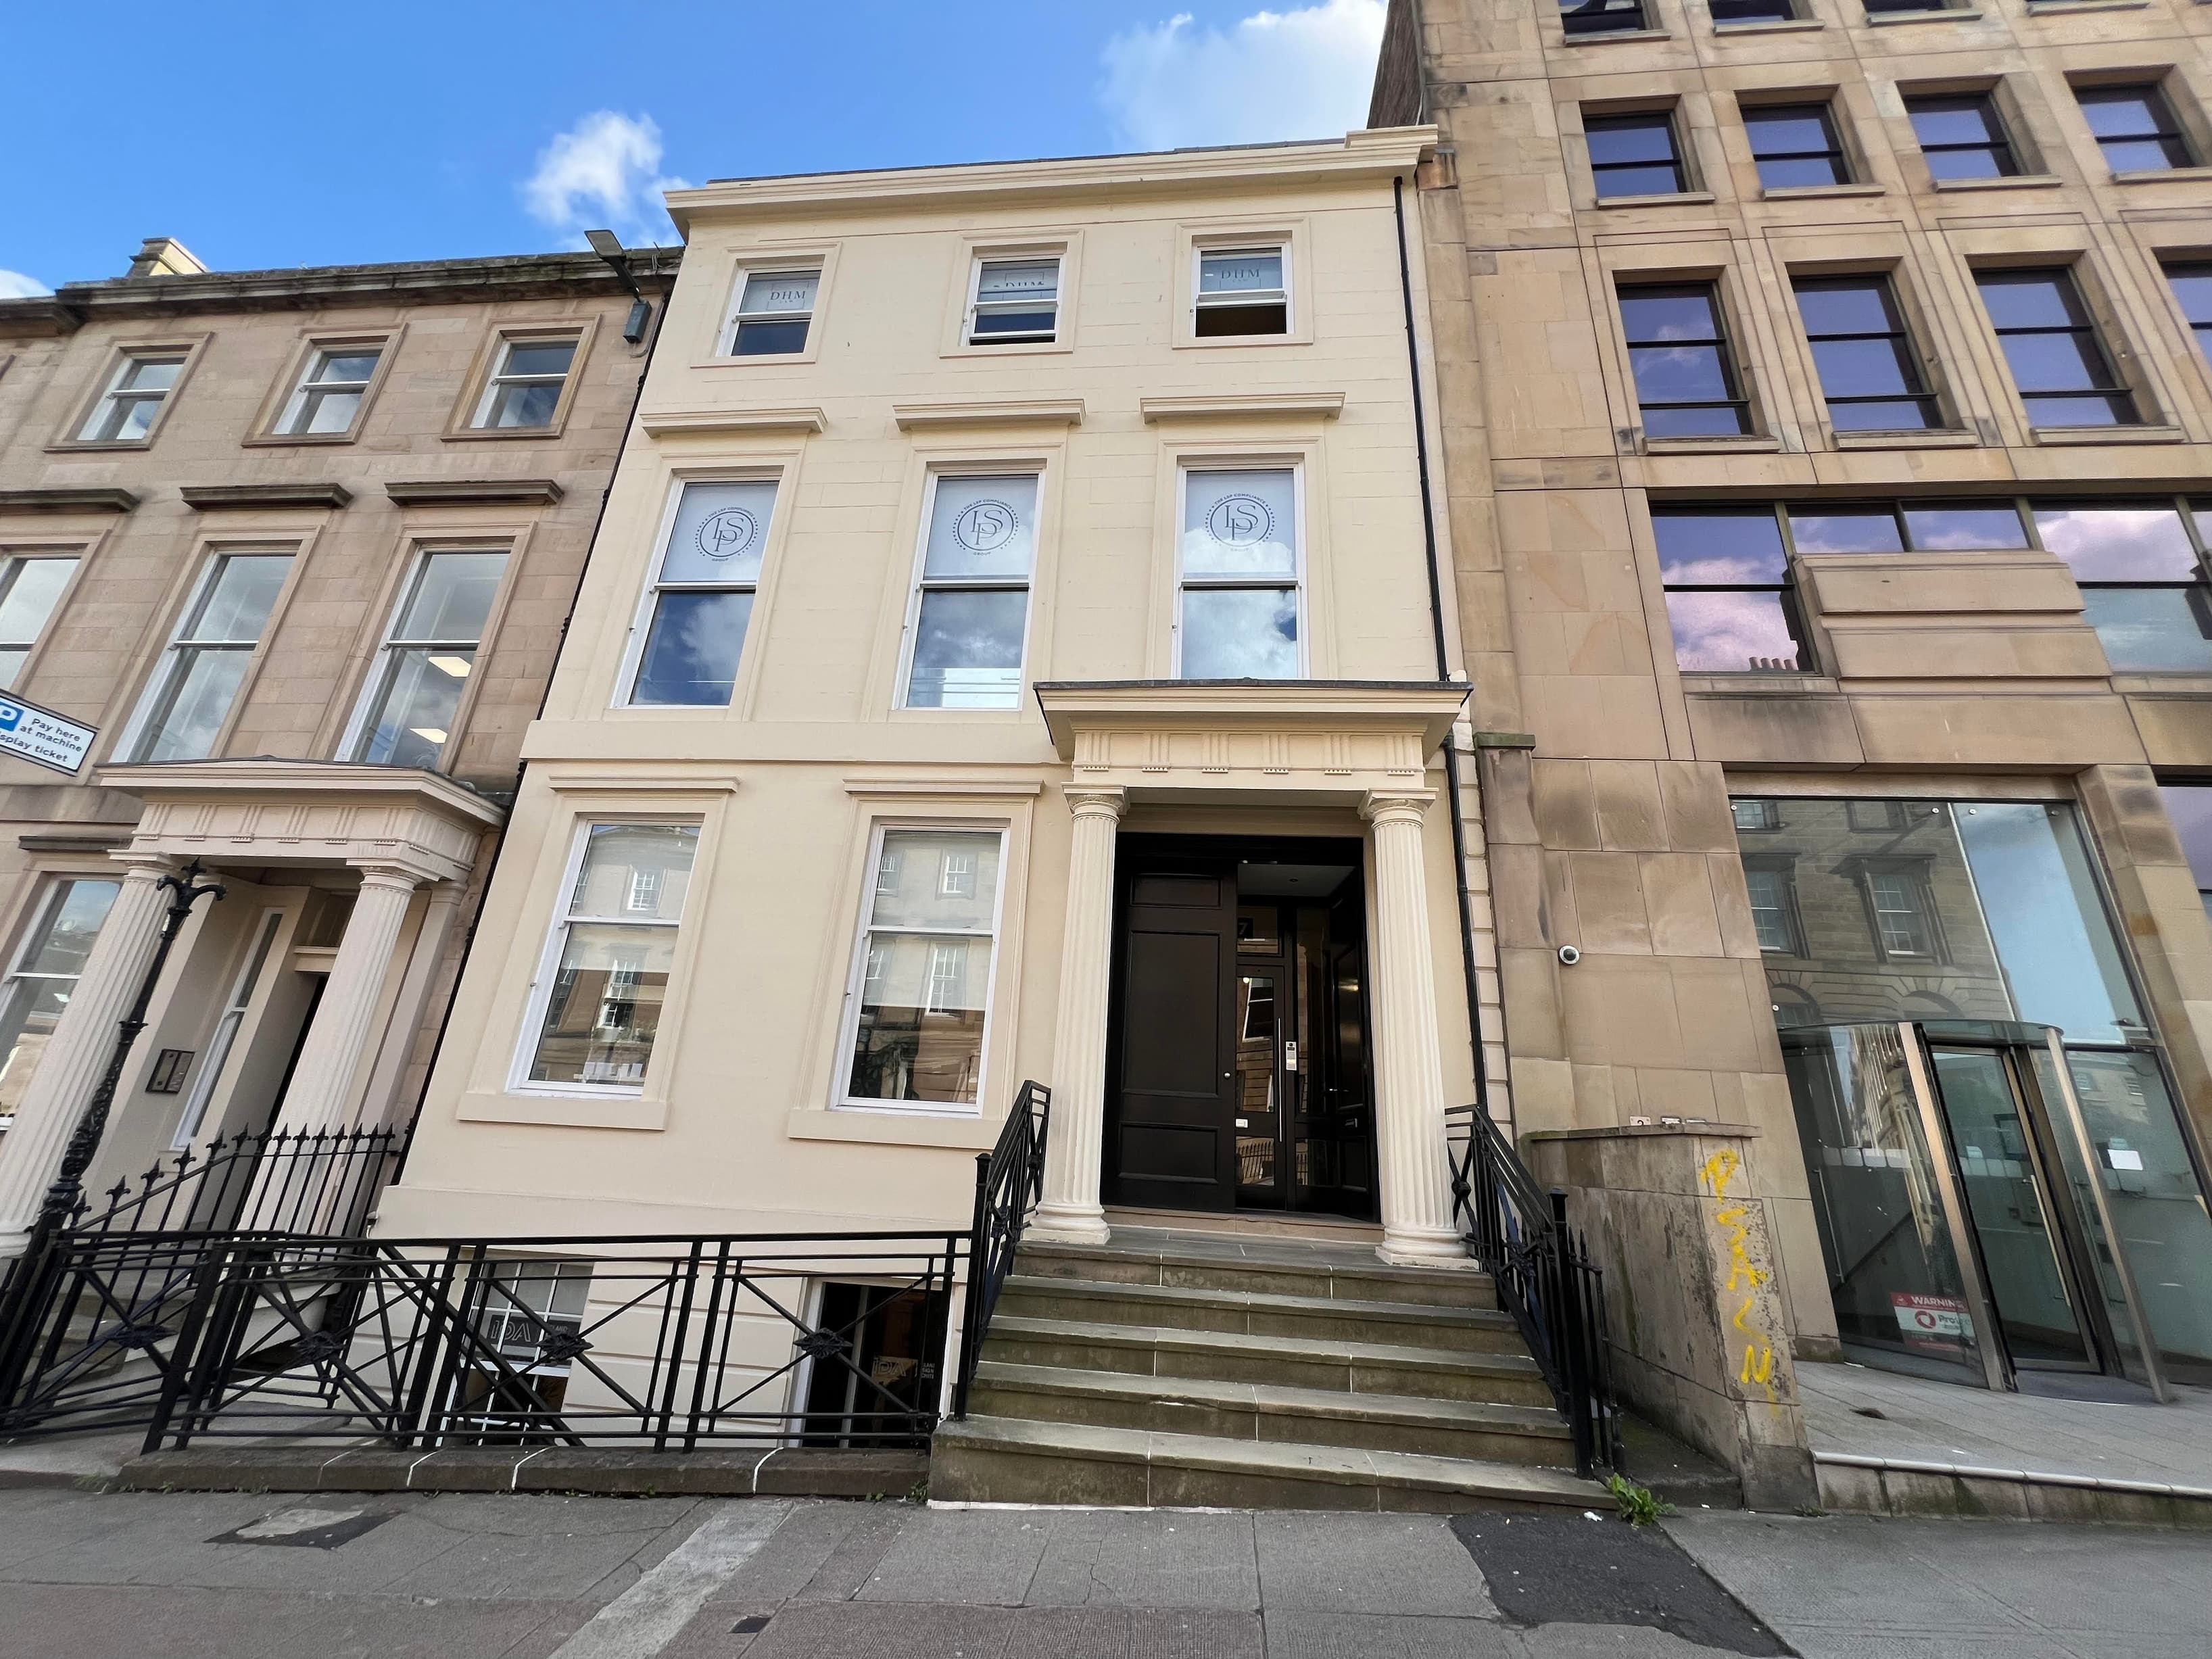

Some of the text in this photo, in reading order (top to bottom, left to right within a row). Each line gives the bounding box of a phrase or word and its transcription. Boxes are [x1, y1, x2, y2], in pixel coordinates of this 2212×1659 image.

[770, 291, 806, 300] DHM
[20, 725, 82, 752] at machine
[32, 718, 80, 742] Pay here
[0, 731, 68, 763] splay ticket
